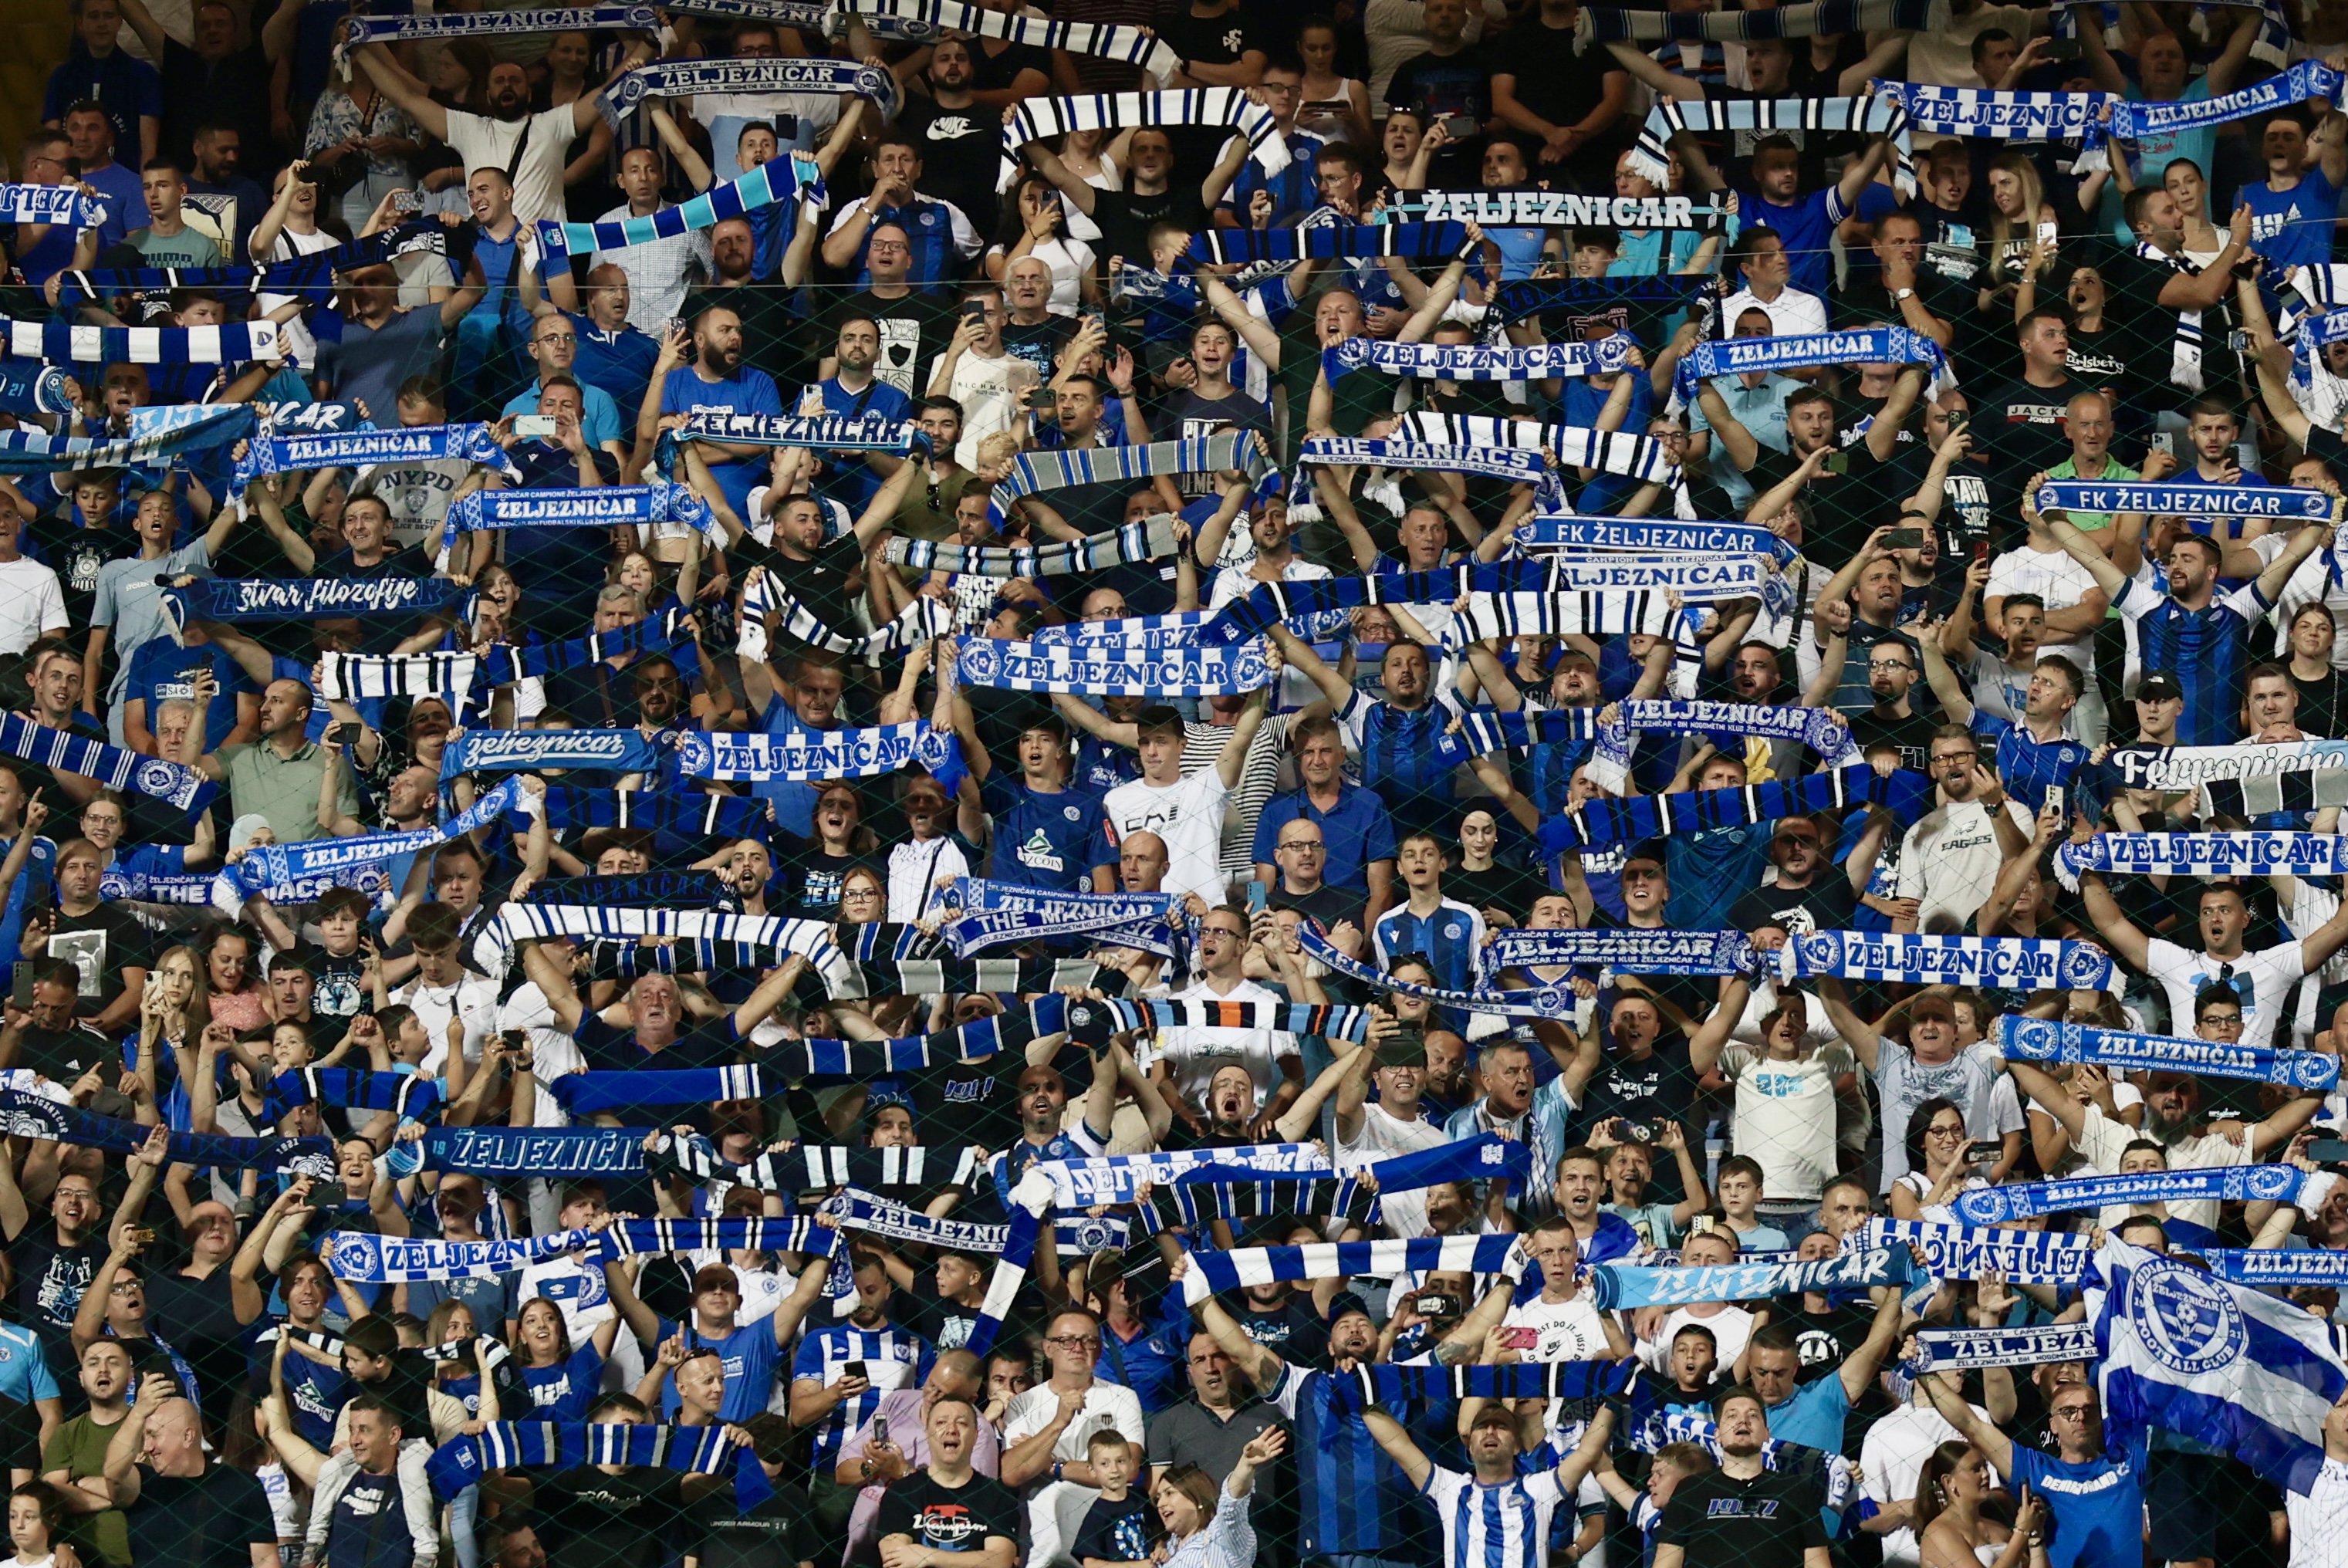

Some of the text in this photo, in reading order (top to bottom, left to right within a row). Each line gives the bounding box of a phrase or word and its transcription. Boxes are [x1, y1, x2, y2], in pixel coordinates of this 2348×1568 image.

[1911, 89, 2103, 128] ŽELJEZNIČA
[940, 116, 971, 134] NIKE
[1729, 332, 1874, 365] ŽELJEZNIČAR
[958, 382, 1019, 395] RICHMON
[2011, 407, 2059, 416] JACK
[2028, 417, 2056, 425] JONES
[287, 432, 434, 461] ŽELJEZNIČAR
[1309, 437, 1532, 470] THE MANIACS
[383, 469, 456, 492] NYPD
[496, 496, 637, 520] ŽELJEZNIČAR
[2079, 487, 2282, 515] FK ŽELJEZNIČAR
[1557, 522, 1757, 553] FK ŽELJEZNIČAR
[1005, 649, 1228, 687] ŽELJEZNIČAR
[464, 729, 626, 769] željezničar
[717, 735, 912, 772] ŽELJEZNIČAR
[1941, 833, 1993, 852] EAGLES
[150, 884, 207, 904] THE
[976, 912, 1029, 934] THE
[1553, 931, 1599, 939] CAMPIONE
[1671, 931, 1718, 940] CAMPIONE
[1573, 955, 1616, 965] NOGOMETNI
[1848, 936, 2054, 978] ŽELJEZNIČAR
[2096, 1032, 2258, 1070] ŽELJEZNIČAR
[432, 1140, 447, 1156] 19
[1536, 1323, 1550, 1336] UST
[2203, 1344, 2236, 1370] CLUB
[709, 1520, 771, 1529] UNDER ARMOUR
